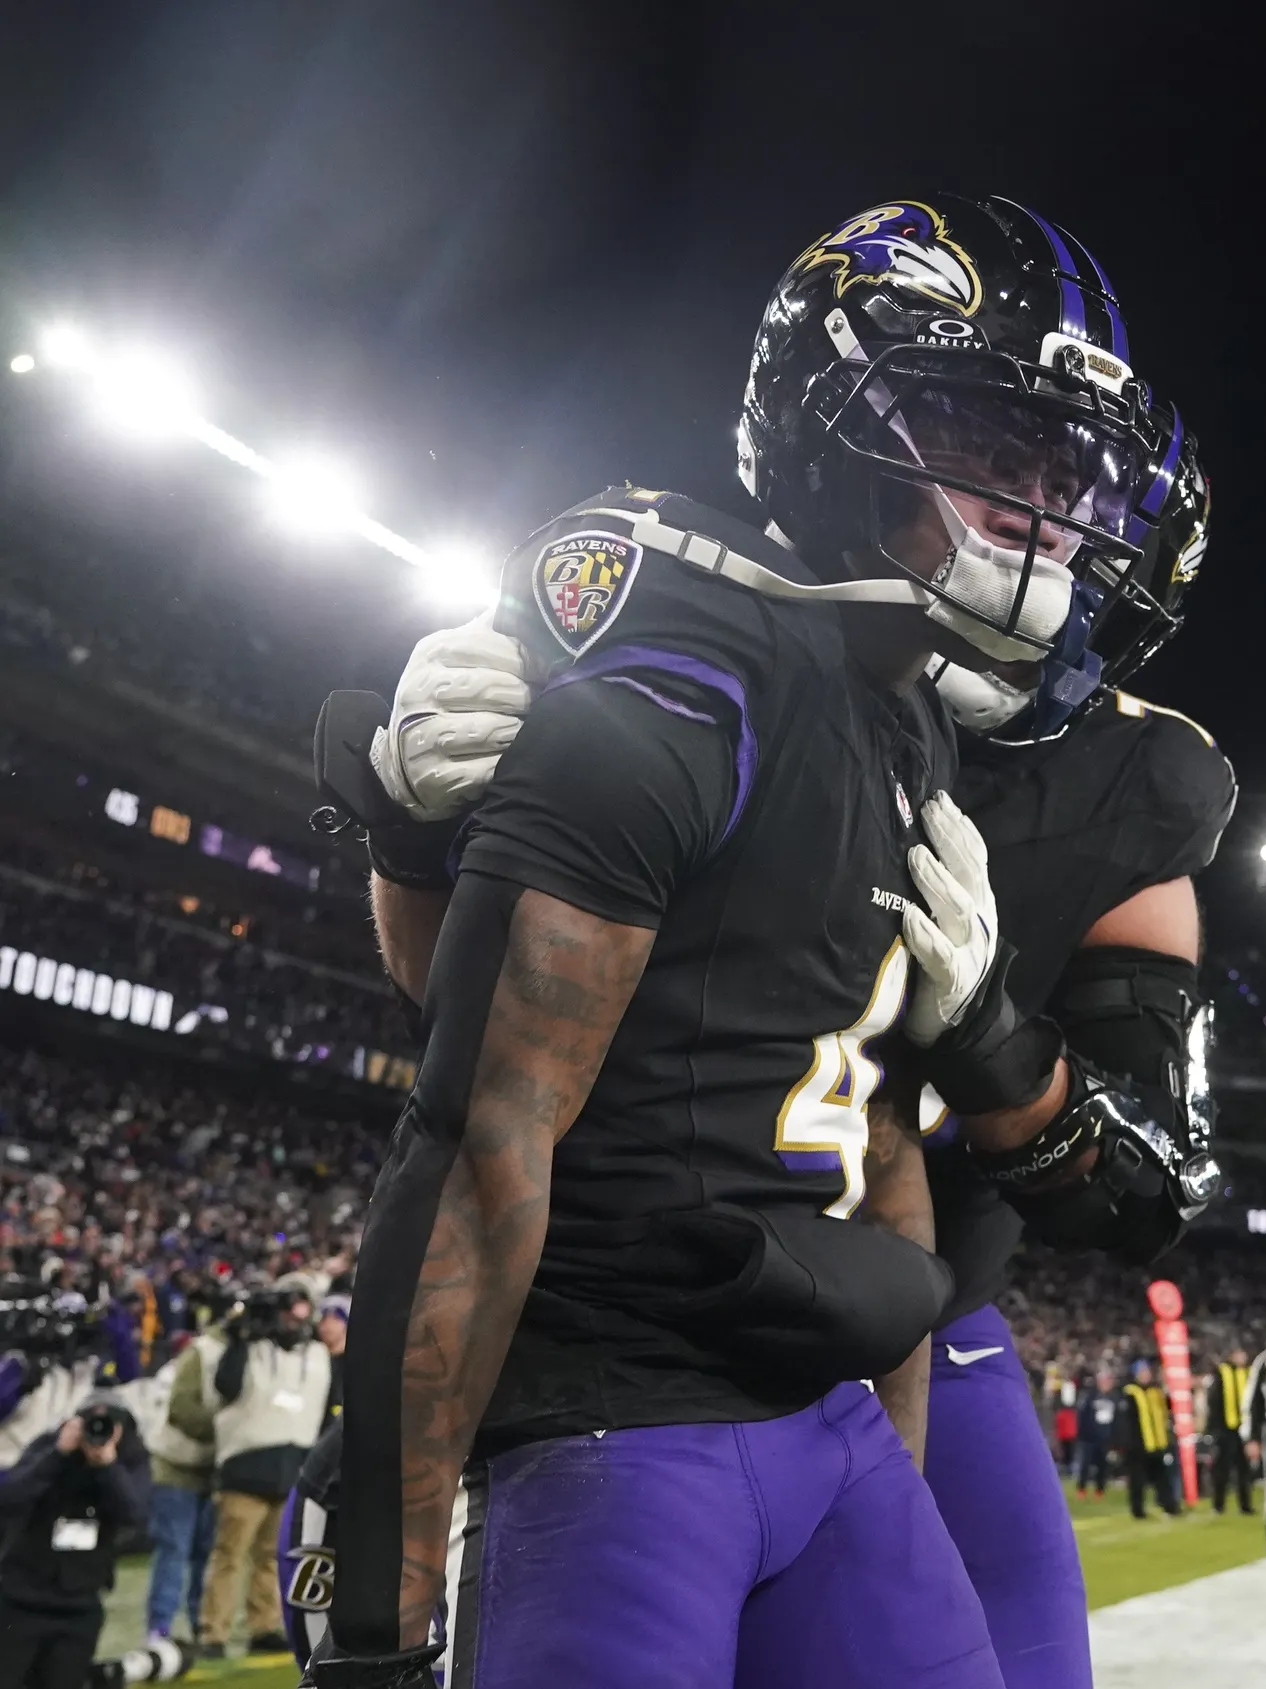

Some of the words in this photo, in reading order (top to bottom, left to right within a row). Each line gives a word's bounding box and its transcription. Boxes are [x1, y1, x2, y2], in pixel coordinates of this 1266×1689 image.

[822, 206, 905, 246] B
[916, 334, 985, 350] OAKLEY
[550, 539, 628, 558] RAVENS
[548, 551, 589, 584] B
[576, 586, 613, 621] R
[870, 886, 915, 913] RAVEN
[774, 934, 911, 1220] 4
[286, 1544, 336, 1611] B
